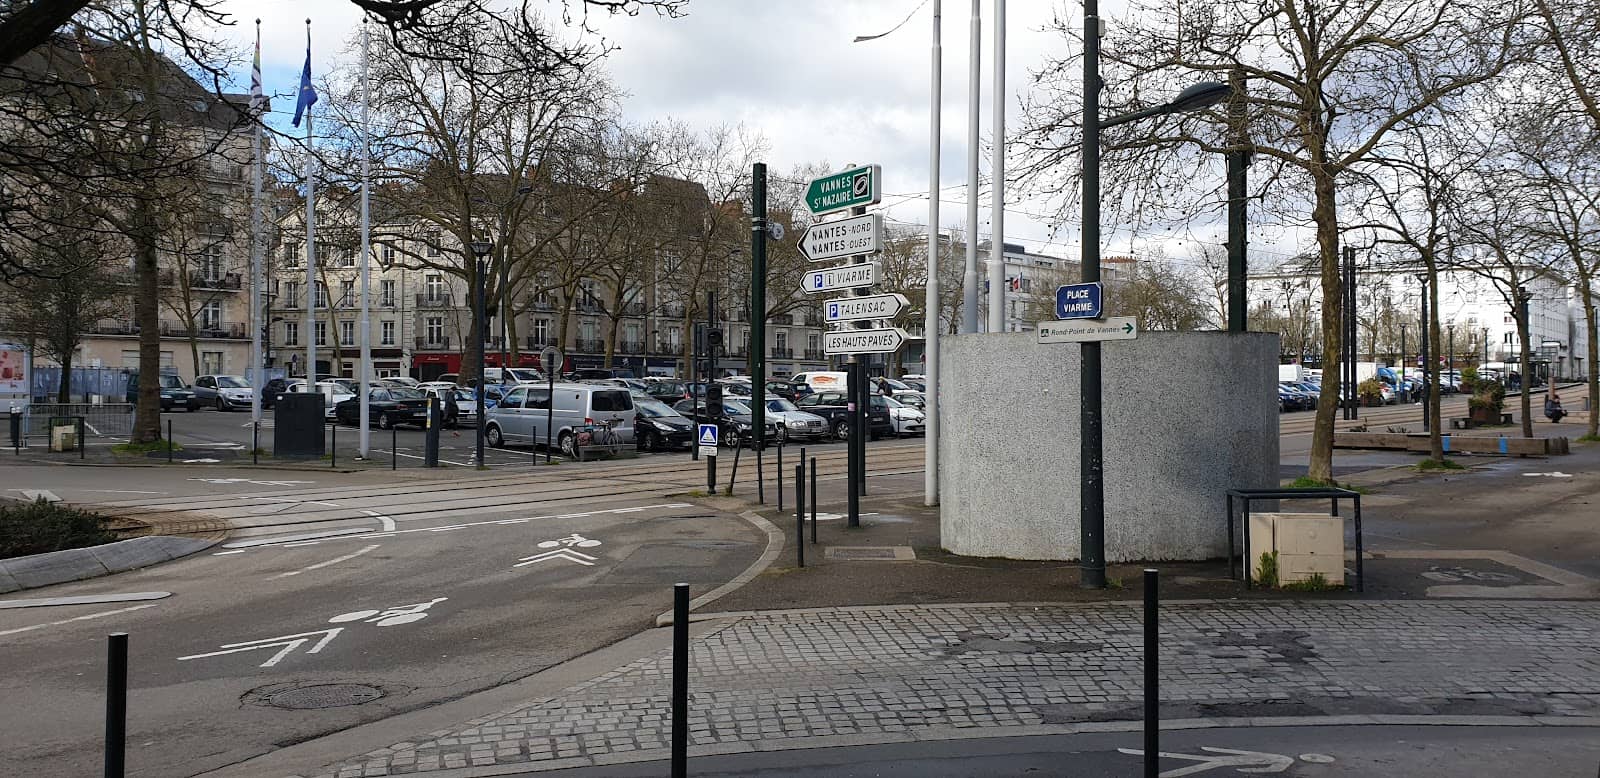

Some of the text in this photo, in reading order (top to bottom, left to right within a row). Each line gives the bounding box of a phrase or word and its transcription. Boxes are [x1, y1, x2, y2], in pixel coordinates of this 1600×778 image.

[821, 176, 851, 193] VANNES
[823, 191, 851, 207] NAZAIRE
[837, 269, 871, 283] VIARME
[1067, 289, 1089, 300] PLACE
[841, 301, 886, 315] TALENSAC
[1063, 302, 1093, 313] VIARME
[1097, 326, 1120, 334] Vannes
[828, 338, 841, 348] LES
[842, 336, 867, 348] HAUTS
